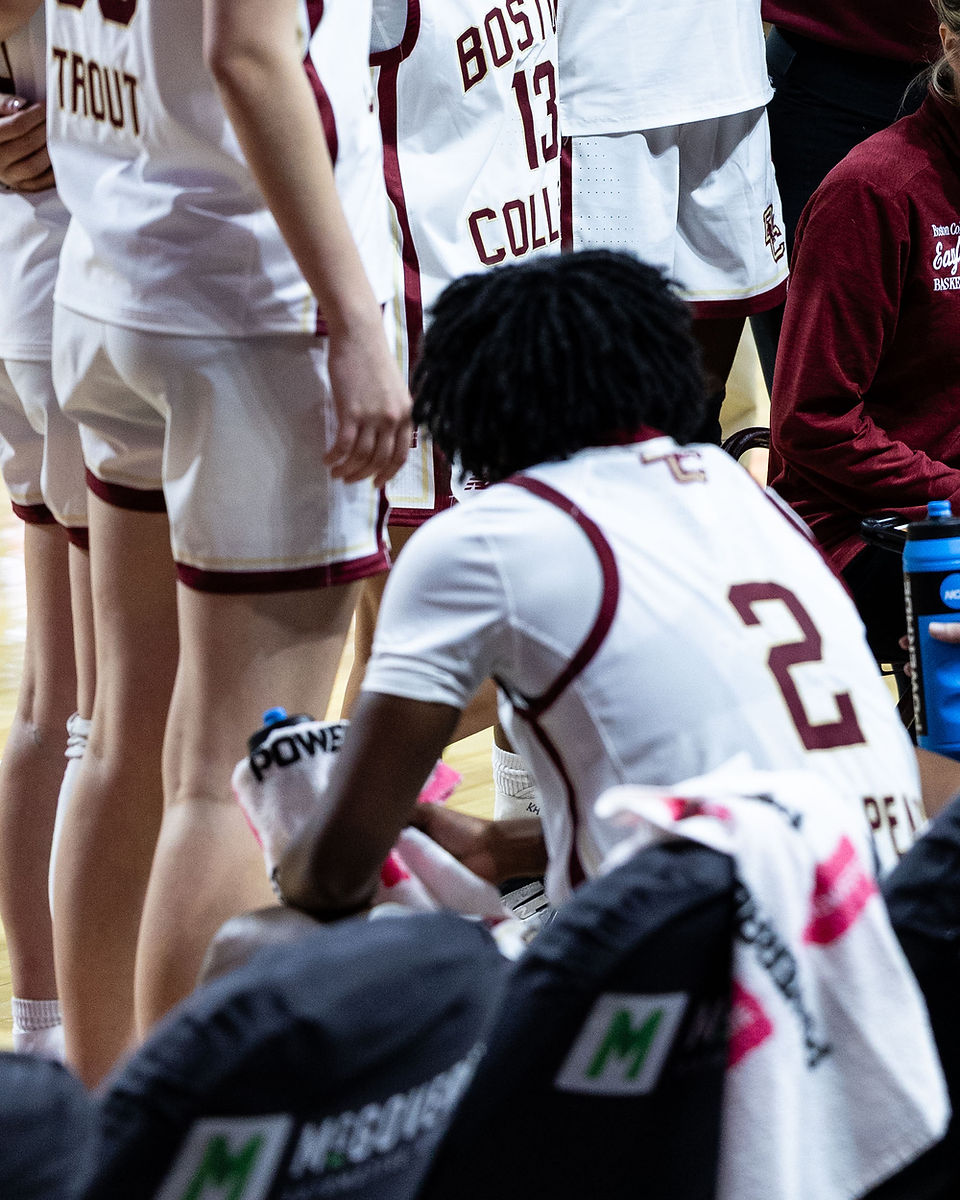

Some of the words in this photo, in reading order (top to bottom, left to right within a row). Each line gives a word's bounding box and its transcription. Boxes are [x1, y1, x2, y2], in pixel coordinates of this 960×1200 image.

[52, 46, 141, 137] TROUT
[511, 60, 561, 171] 13
[727, 581, 867, 752] 2
